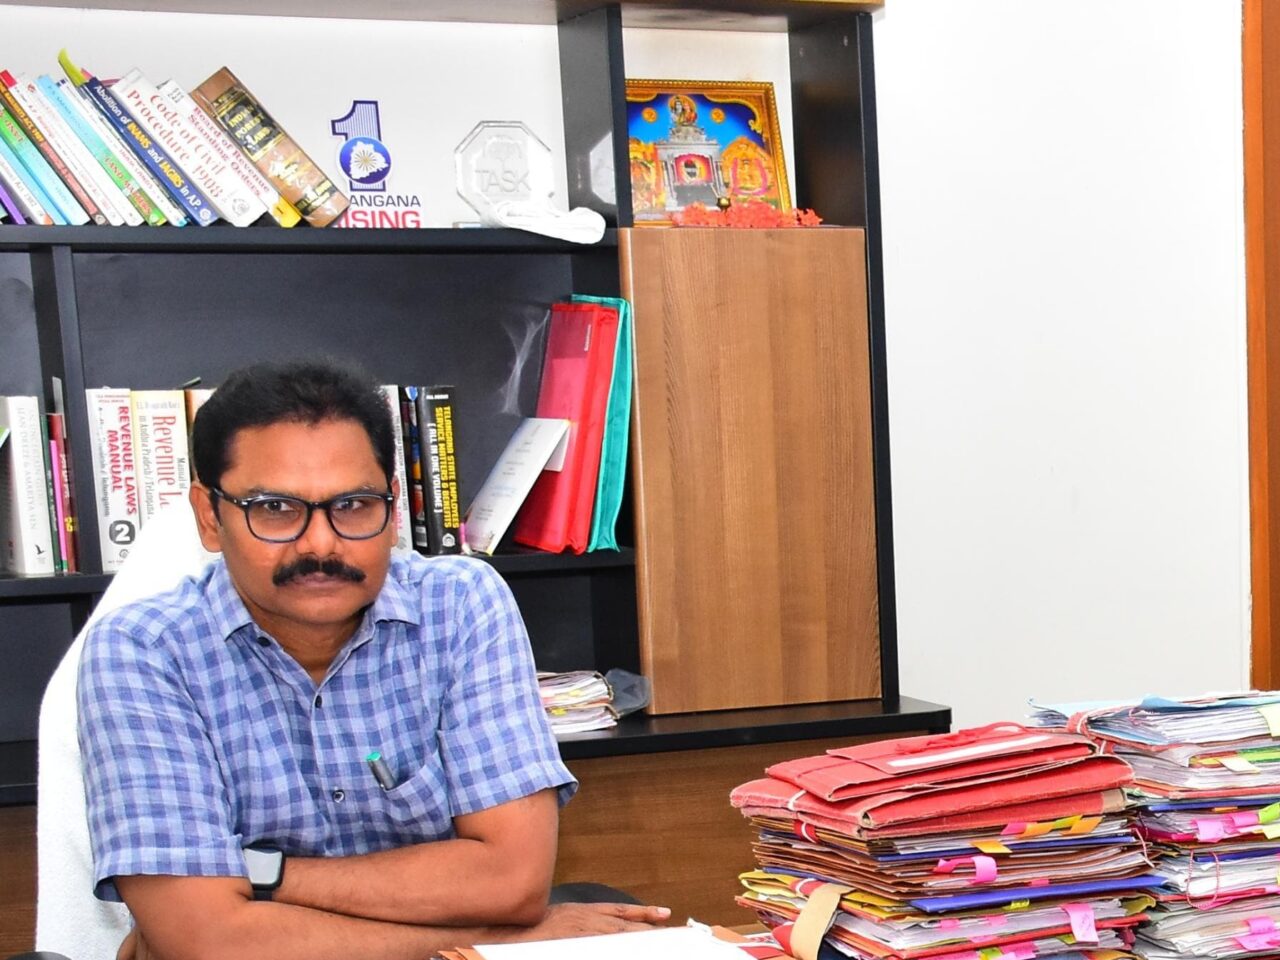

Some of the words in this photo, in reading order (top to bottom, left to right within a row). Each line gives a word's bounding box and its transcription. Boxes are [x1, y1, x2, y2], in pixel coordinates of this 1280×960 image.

[93, 82, 124, 117] Abolition
[119, 112, 132, 126] of
[125, 120, 152, 149] INAMS
[148, 90, 184, 130] Code
[178, 124, 198, 145] of
[192, 140, 226, 177] Civil
[146, 145, 164, 164] and
[186, 112, 231, 162] Standing
[228, 159, 263, 198] Orders
[192, 105, 222, 138] Board
[220, 136, 234, 151] of
[230, 148, 271, 194] Revenue
[158, 159, 185, 189] JAGIRS
[179, 184, 192, 196] in
[191, 163, 224, 199] 1908
[475, 170, 532, 193] TASK
[185, 191, 203, 210] A.P.
[350, 195, 421, 208] ANGANA
[118, 405, 133, 471] REVENUE
[139, 423, 149, 447] Andhra
[428, 428, 437, 443] ALL
[434, 406, 445, 441] SERVICE
[443, 405, 453, 454] TELANGANA
[107, 429, 122, 492] MANUAL
[141, 448, 153, 475] Pradesh
[152, 415, 176, 485] Revenue
[430, 444, 438, 454] IN
[431, 454, 439, 473] ONE
[437, 442, 448, 480] MATTERS
[176, 457, 186, 481] Manual
[446, 454, 456, 480] STATE
[124, 476, 136, 515] LAWS
[144, 480, 155, 515] Telangana
[432, 473, 441, 508] VOLUME
[448, 481, 459, 528] EMPLOYEES
[441, 489, 452, 528] BENEFITS
